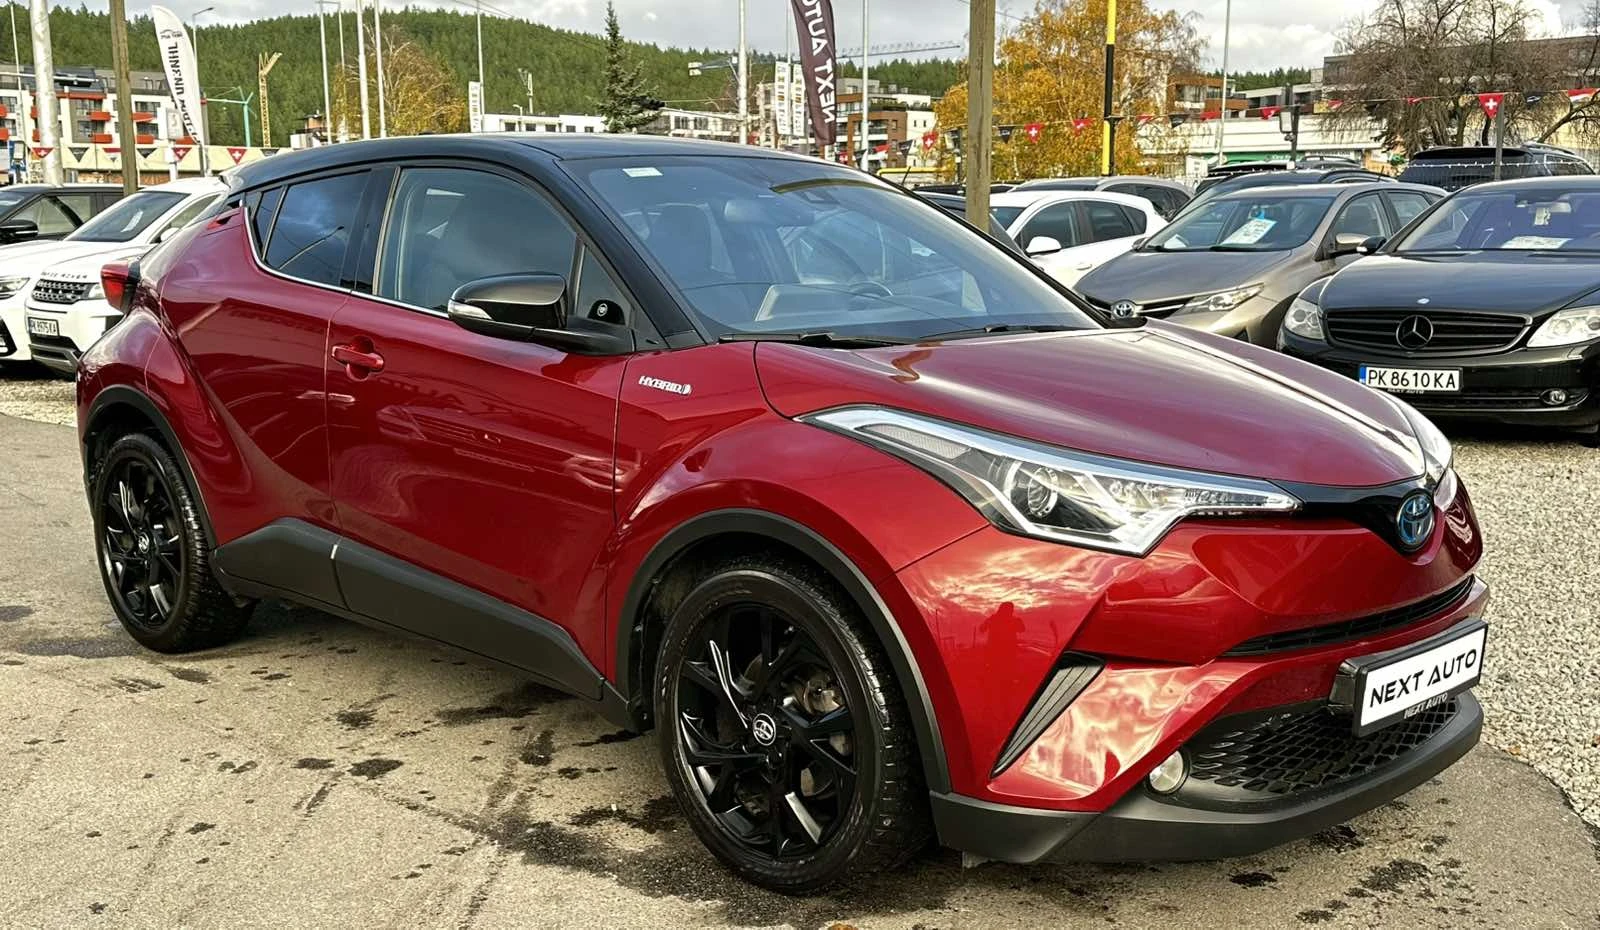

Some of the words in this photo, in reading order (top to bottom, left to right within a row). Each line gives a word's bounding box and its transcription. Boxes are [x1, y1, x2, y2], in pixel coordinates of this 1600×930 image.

[638, 375, 684, 394] HYBRID
[1390, 371, 1431, 388] 8610
[1369, 669, 1425, 708] NEXT
[1426, 648, 1477, 687] AUTO
[1403, 700, 1426, 720] NEXT
[1425, 692, 1448, 710] AUTO
